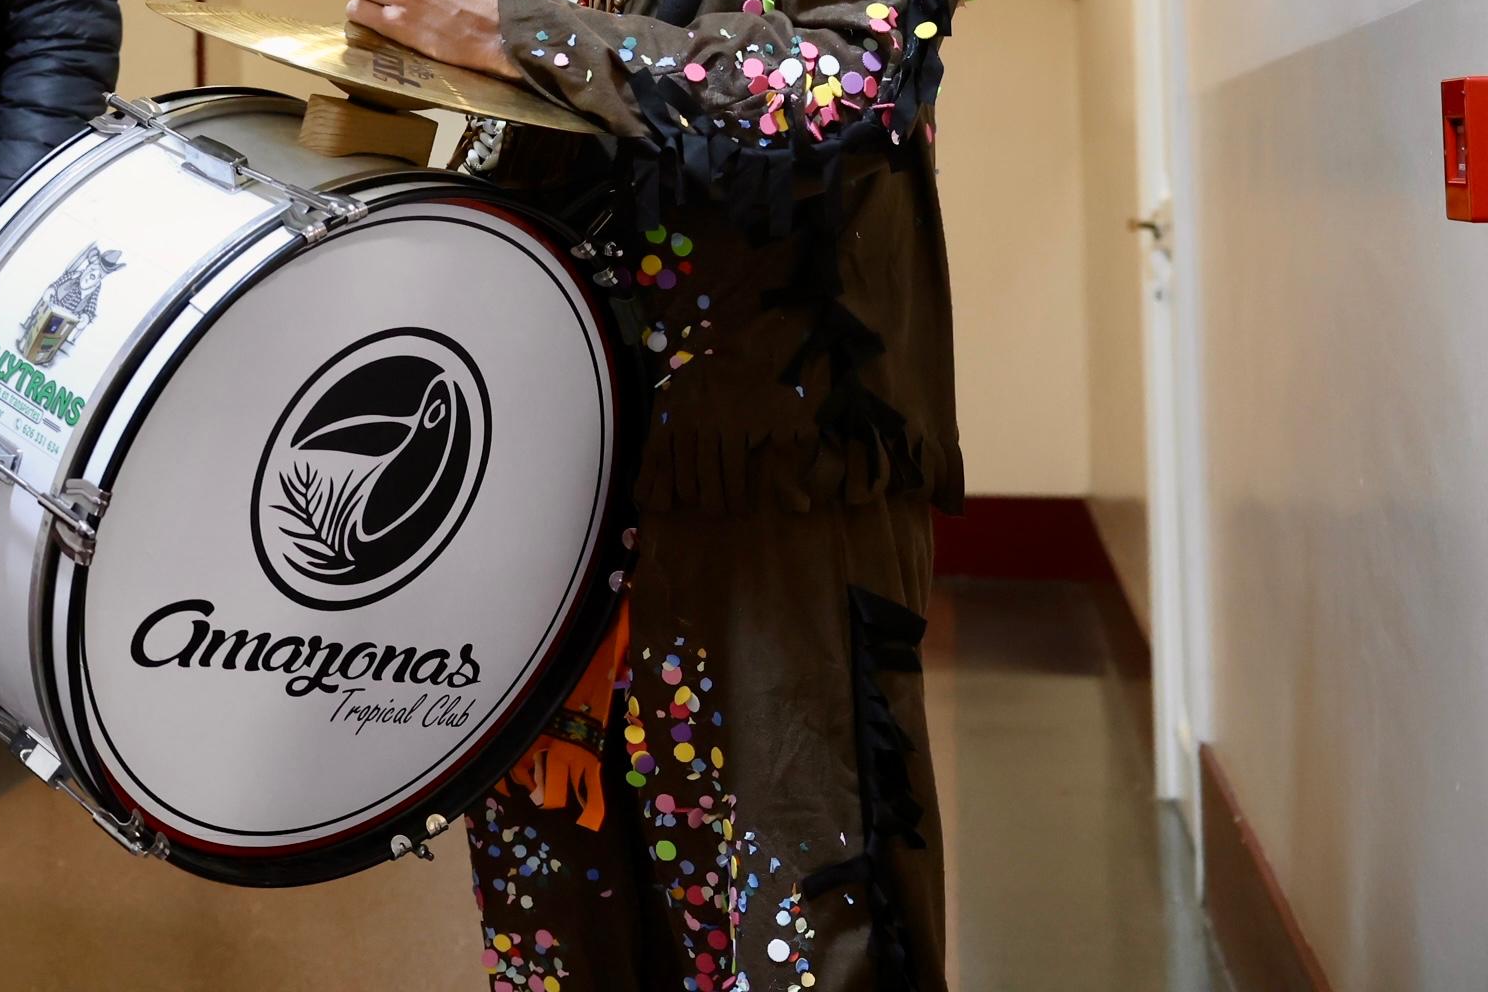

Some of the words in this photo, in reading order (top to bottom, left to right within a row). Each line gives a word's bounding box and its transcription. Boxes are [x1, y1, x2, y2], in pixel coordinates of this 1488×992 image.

[130, 599, 481, 697] Amazonas
[330, 688, 428, 735] Tropical
[422, 694, 476, 728] Club
